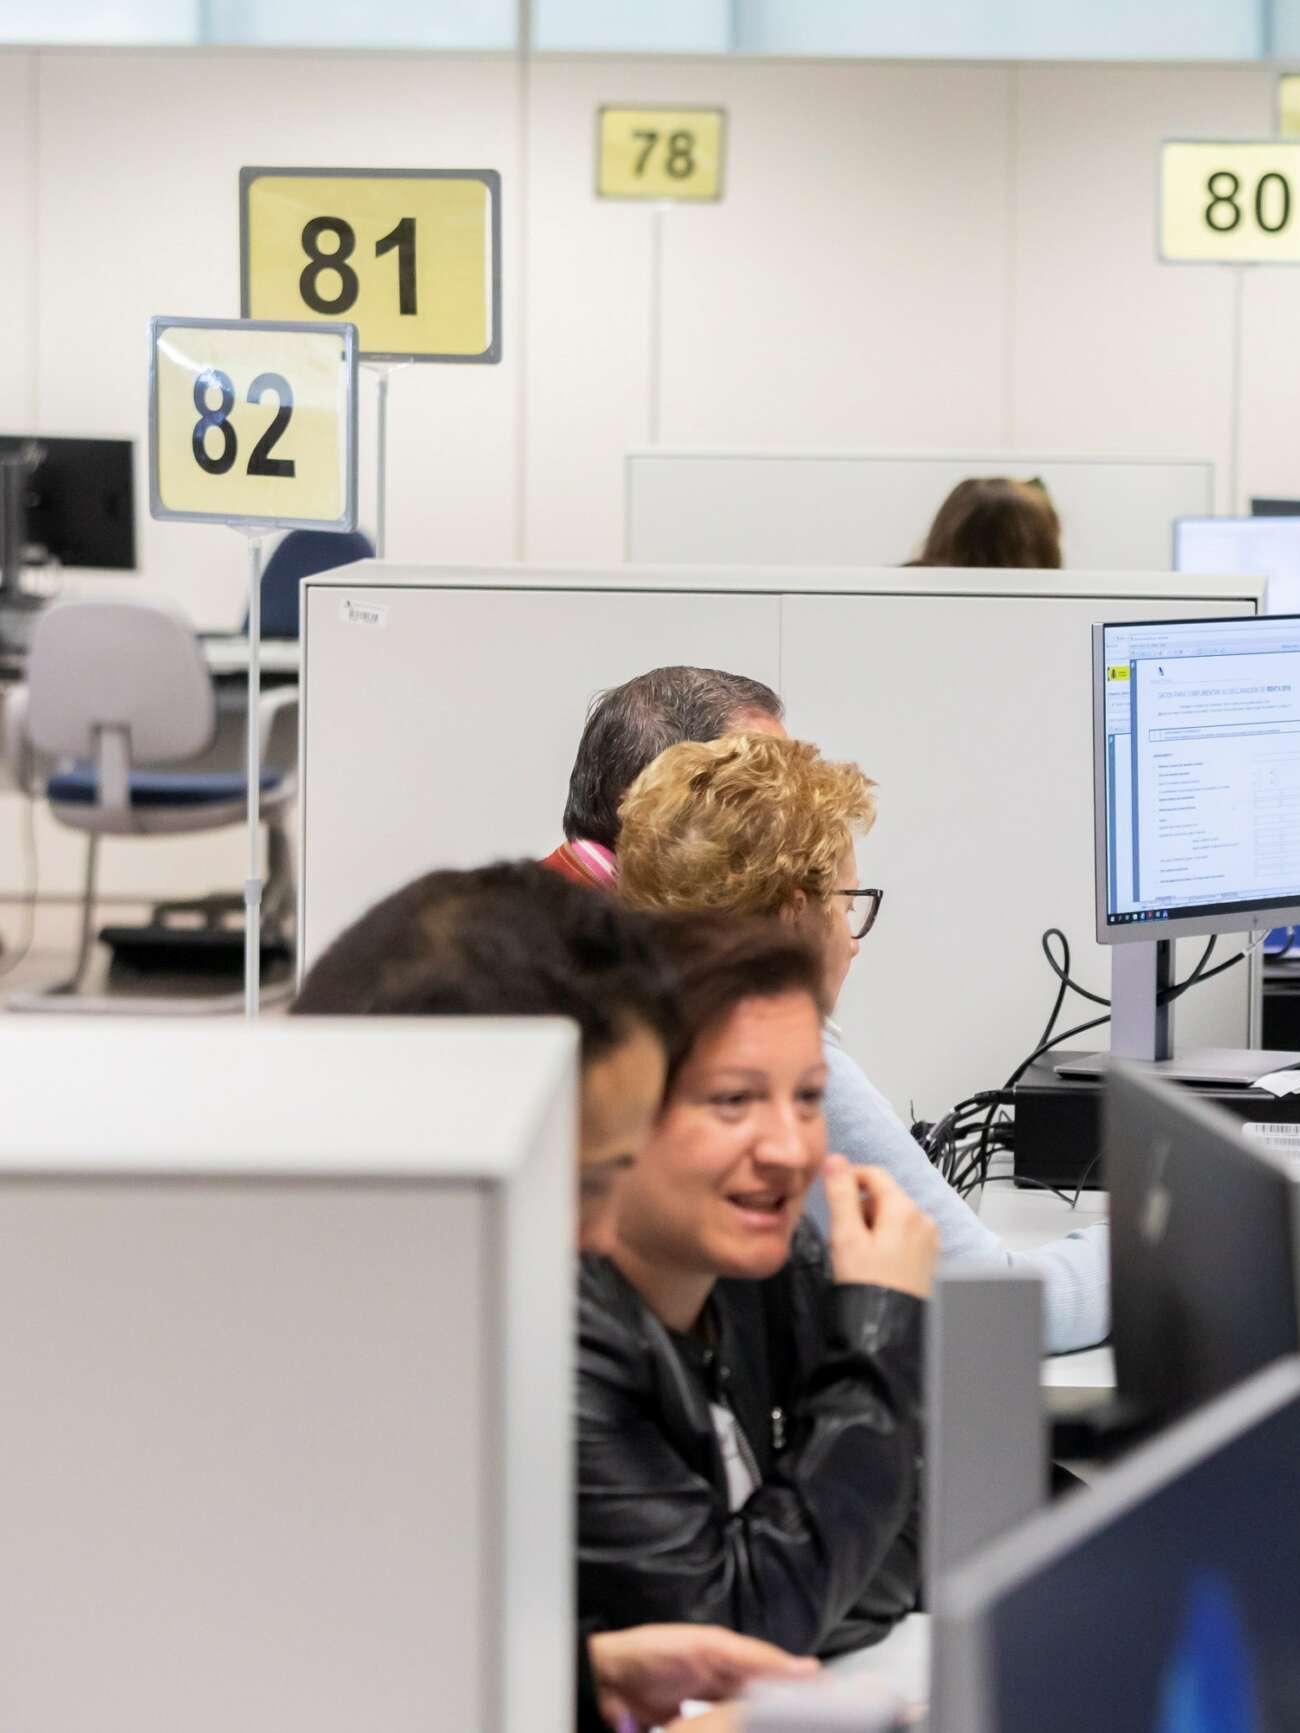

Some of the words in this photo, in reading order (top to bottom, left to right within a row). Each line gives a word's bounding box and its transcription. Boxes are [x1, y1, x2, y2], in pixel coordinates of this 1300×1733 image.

[631, 130, 696, 180] 78
[1204, 171, 1291, 232] 80
[298, 215, 418, 317] 81
[191, 369, 296, 478] 82
